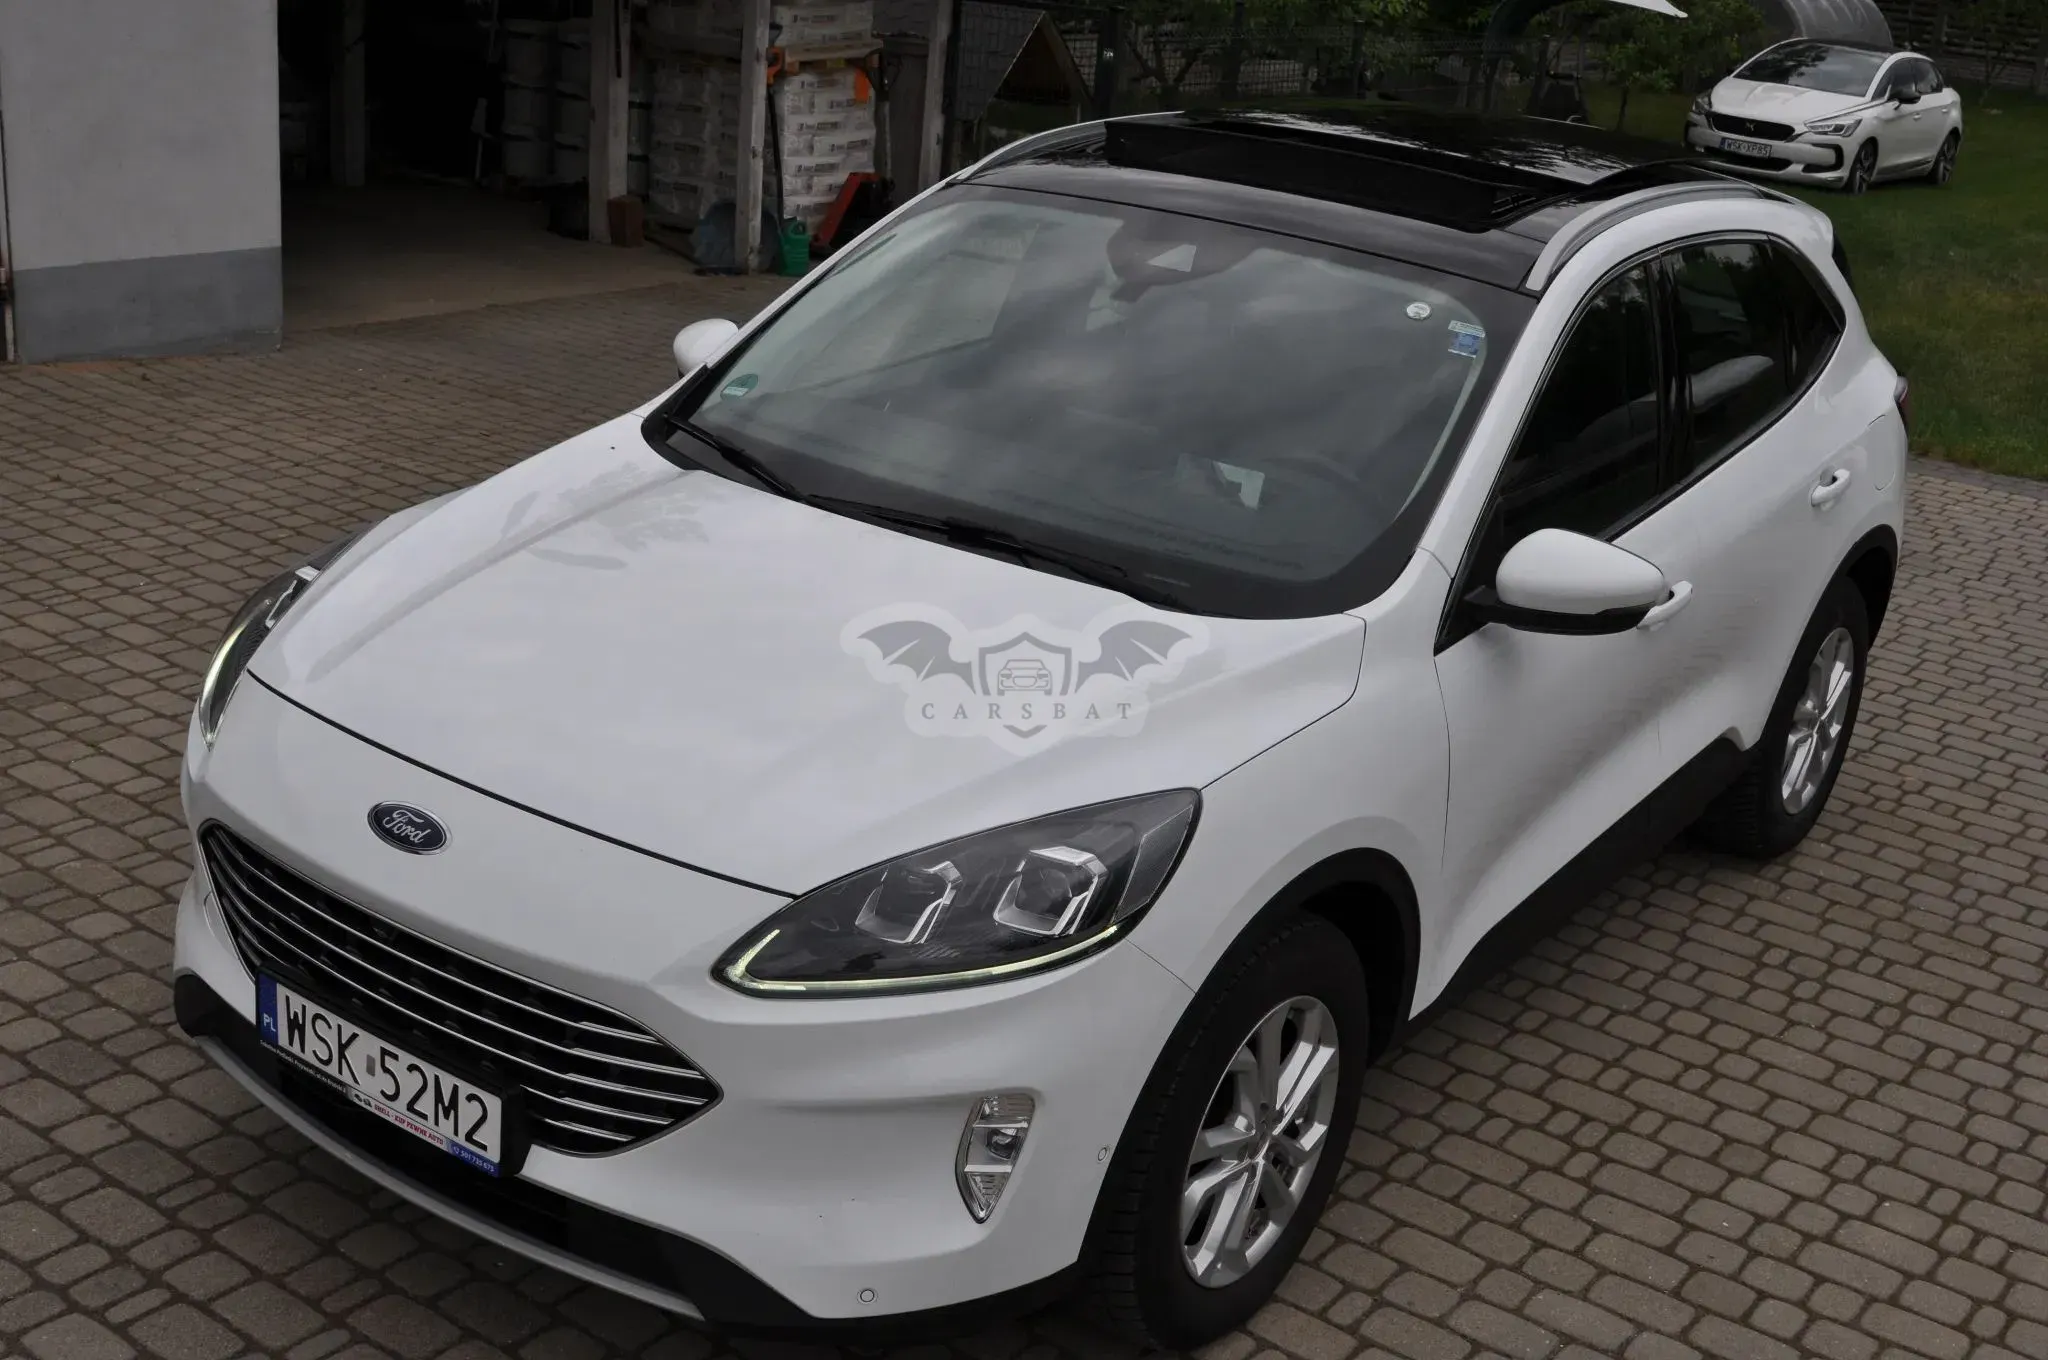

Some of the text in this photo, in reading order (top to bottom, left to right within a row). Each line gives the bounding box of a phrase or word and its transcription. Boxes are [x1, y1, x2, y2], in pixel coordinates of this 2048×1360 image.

[1726, 139, 1744, 151] WSK
[383, 809, 431, 843] Ford
[263, 1013, 276, 1033] PL
[285, 994, 360, 1085] WSK
[379, 1046, 488, 1153] 52M2
